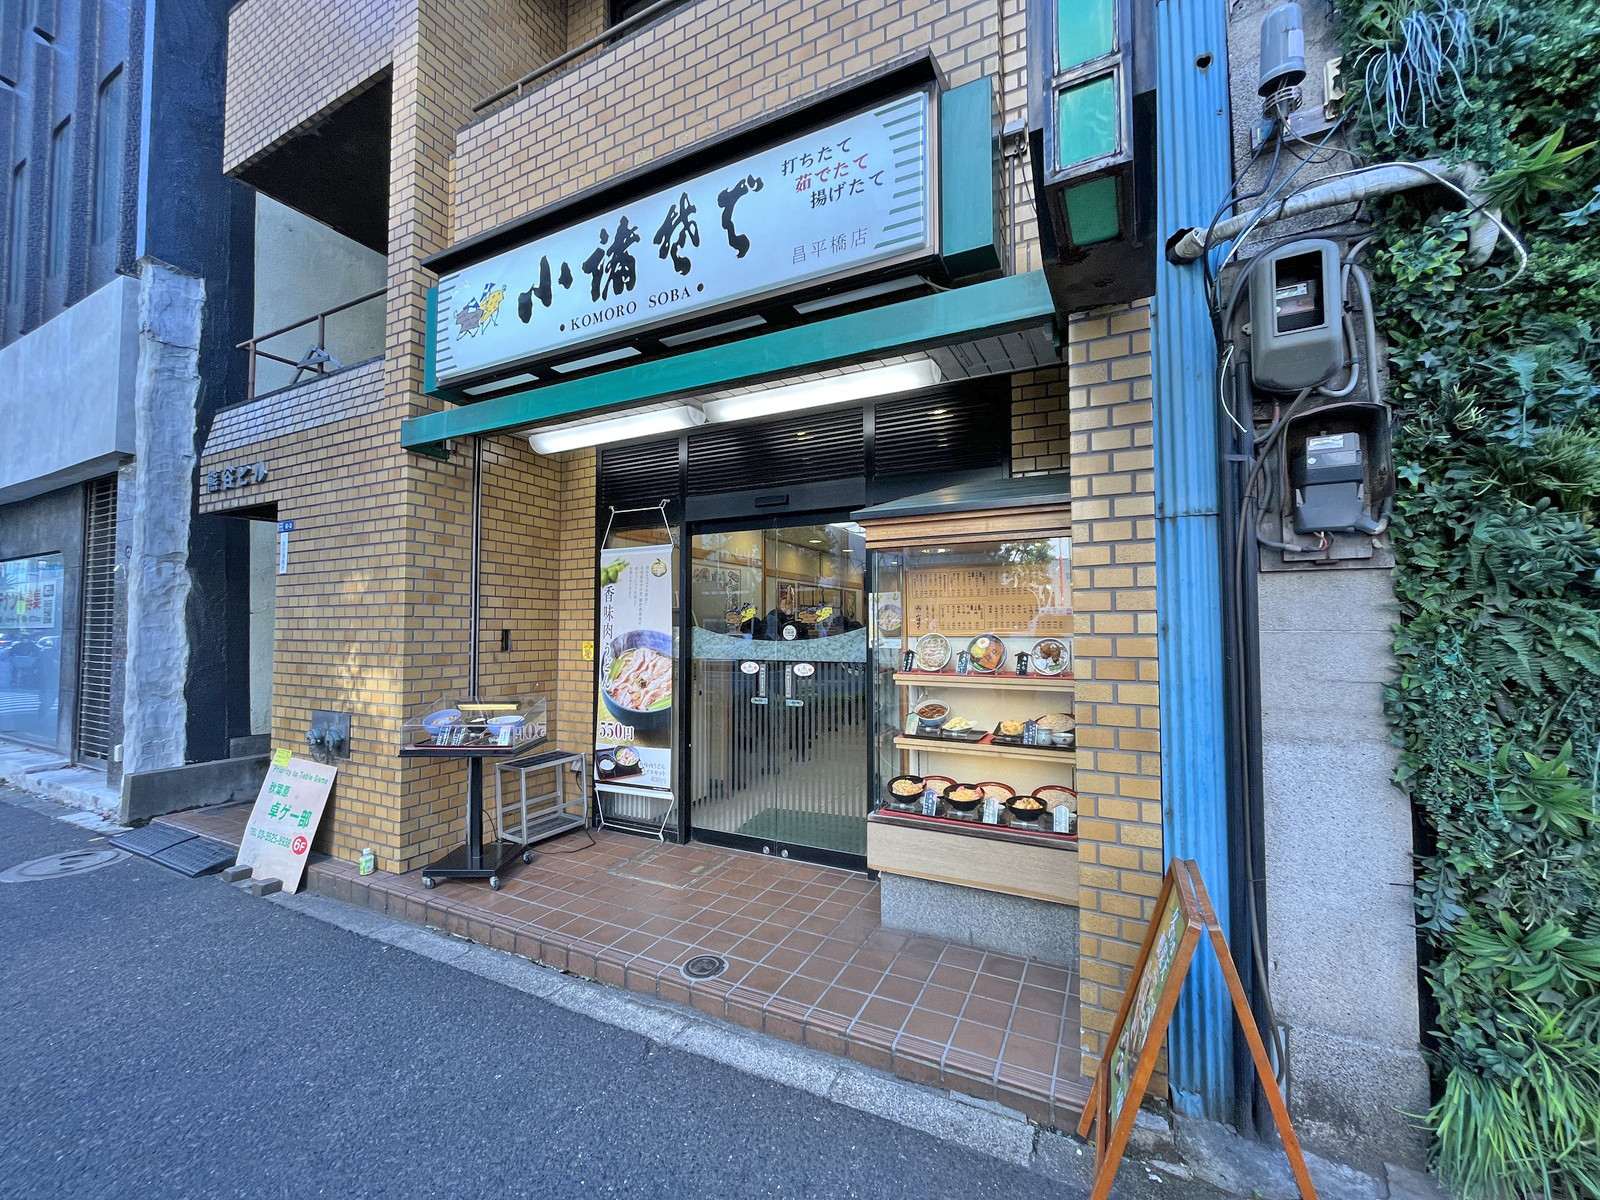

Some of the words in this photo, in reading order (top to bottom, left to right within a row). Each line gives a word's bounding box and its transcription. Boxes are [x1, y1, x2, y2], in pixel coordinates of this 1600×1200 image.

[781, 137, 852, 178] 打ちたて
[795, 152, 869, 193] 茹でたて
[810, 169, 885, 209] 揚げたて
[791, 227, 868, 265] 昌平橋店
[570, 301, 637, 331] KOMORO
[648, 285, 691, 310] SOBA
[602, 585, 614, 689] 香味肉うどん
[599, 721, 635, 741] 550円
[268, 781, 291, 797] 秋葉原
[299, 771, 313, 781] Table
[314, 774, 329, 785] Game
[268, 802, 313, 829] 卓ゲー部
[293, 839, 307, 852] 6F
